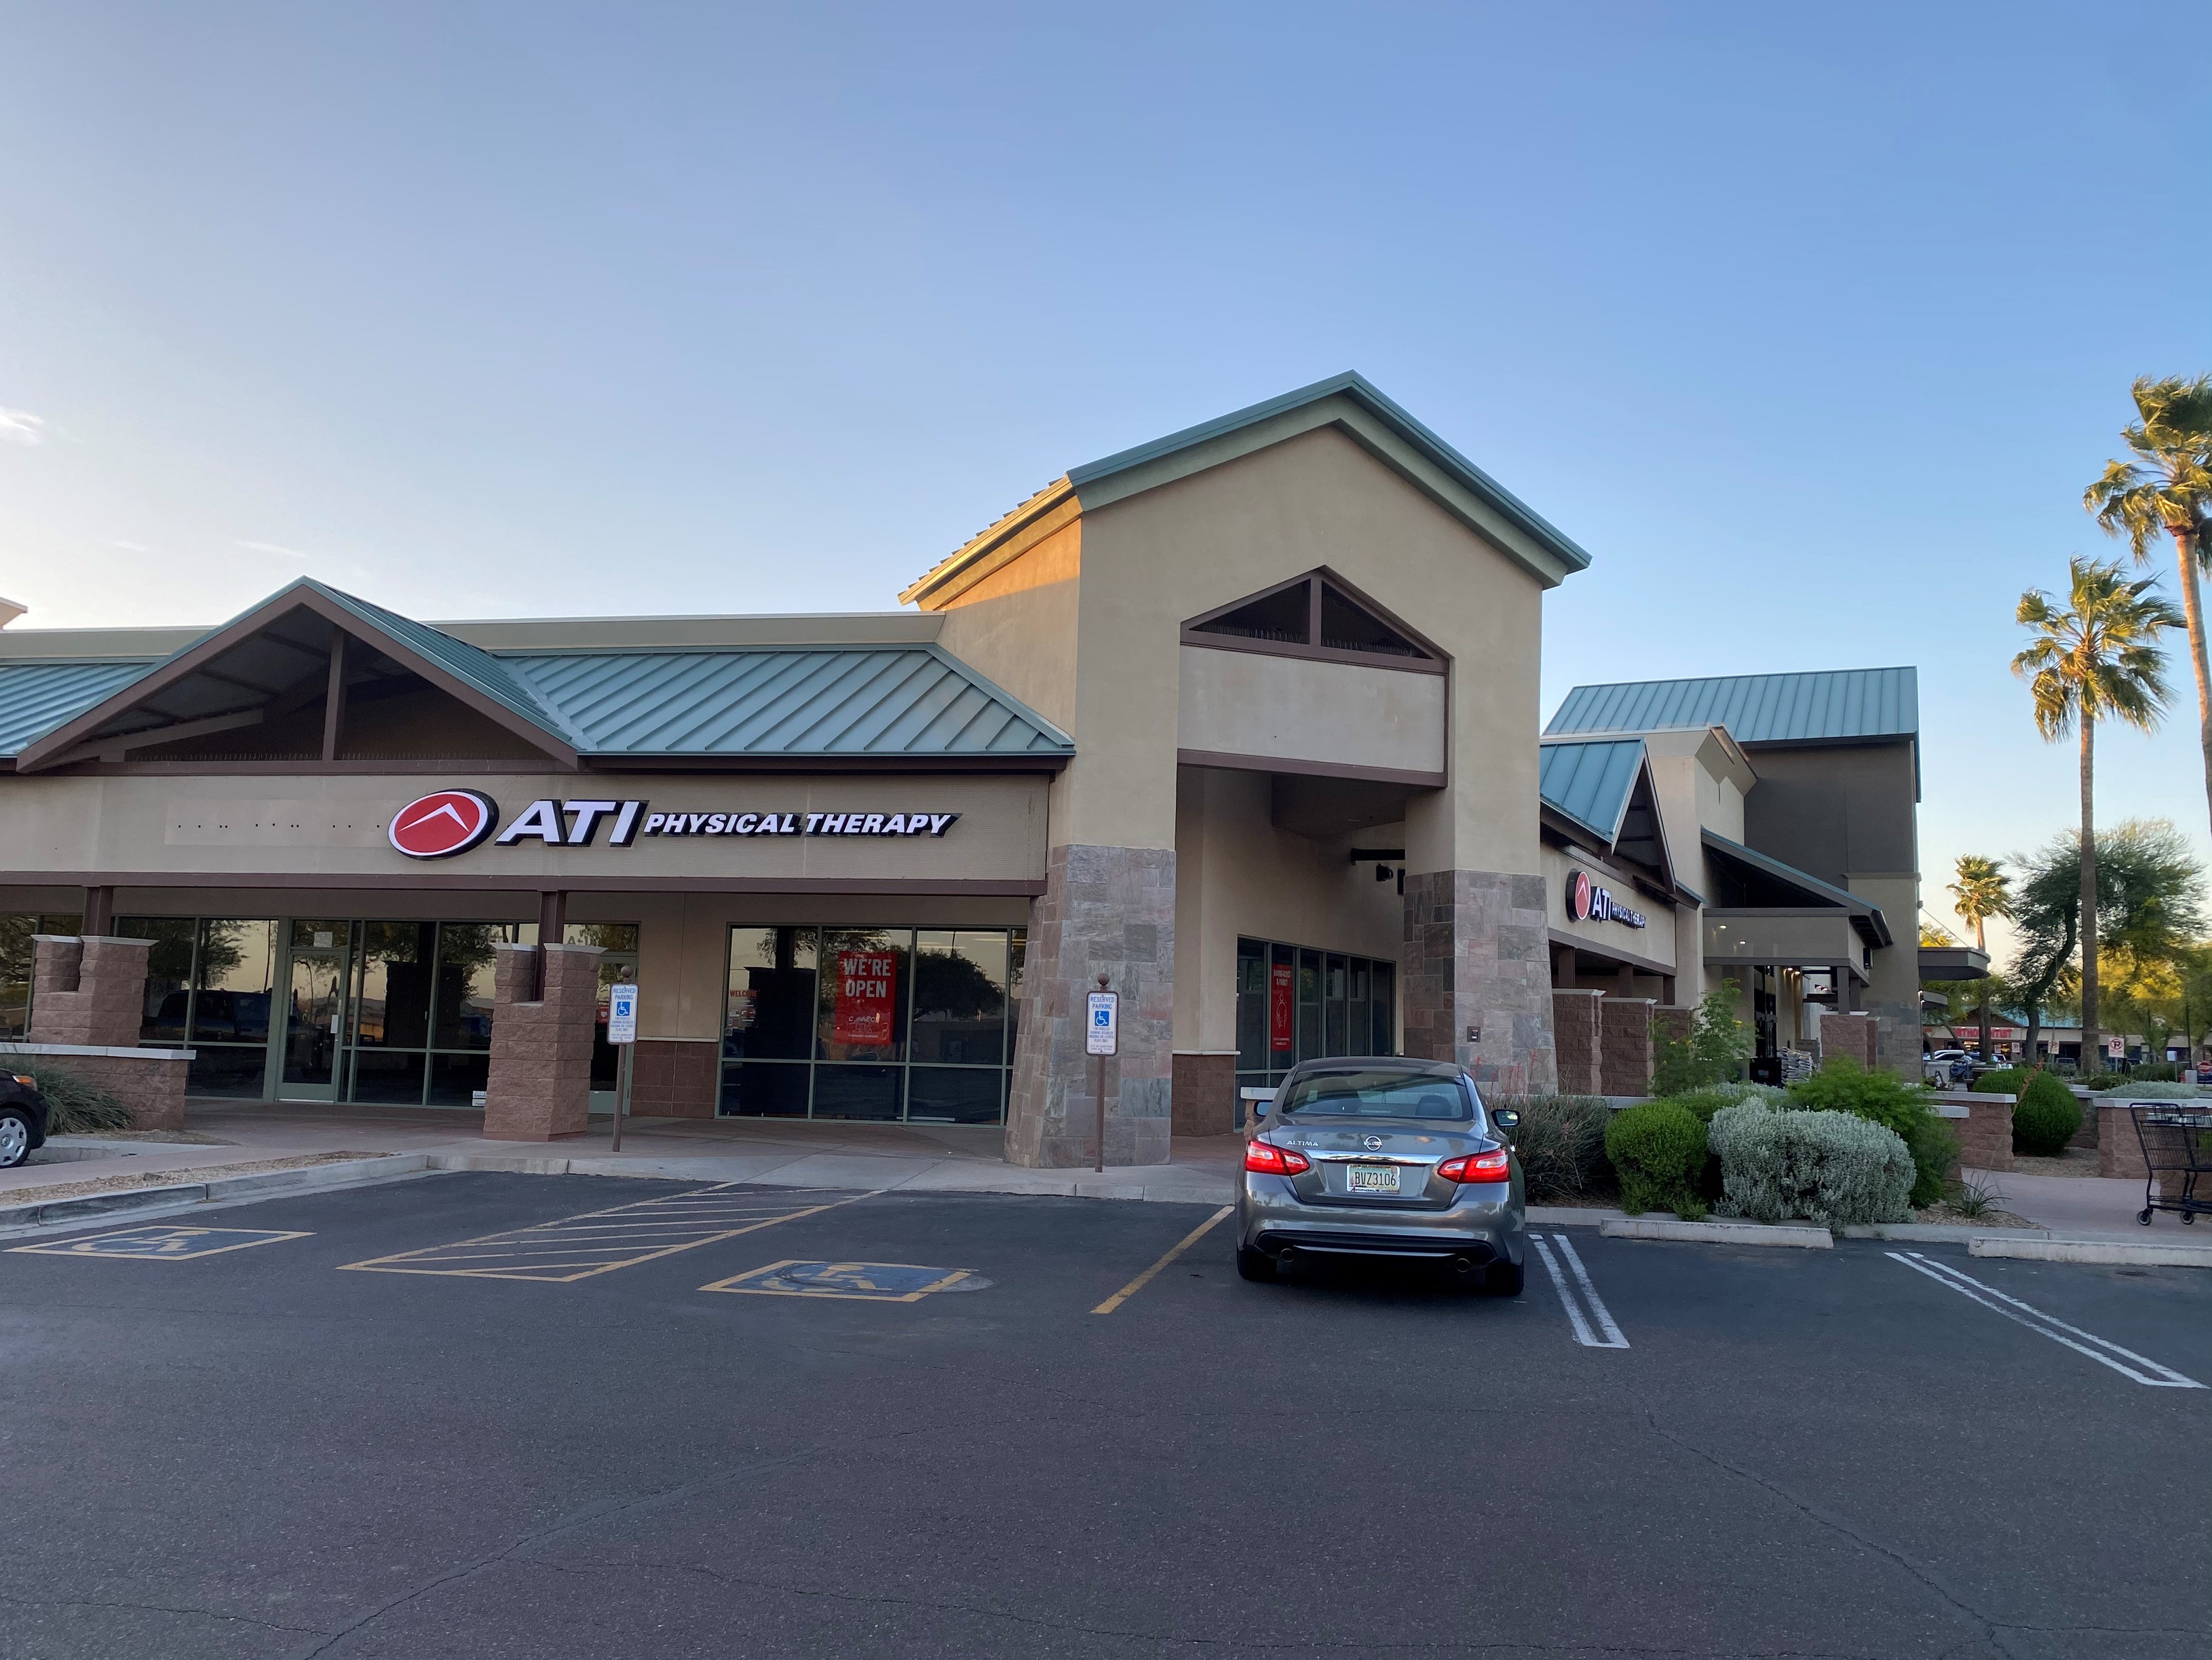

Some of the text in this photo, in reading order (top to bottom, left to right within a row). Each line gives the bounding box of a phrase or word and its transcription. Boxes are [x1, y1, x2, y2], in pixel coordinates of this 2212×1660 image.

[495, 800, 952, 843] ATI PHYSICAL THERAPY
[1592, 886, 1612, 921] ATI
[843, 958, 892, 977] WE'RE
[729, 989, 758, 998] WELCOME
[845, 979, 887, 998] OPEN
[1354, 1171, 1396, 1186] BVZ3106
